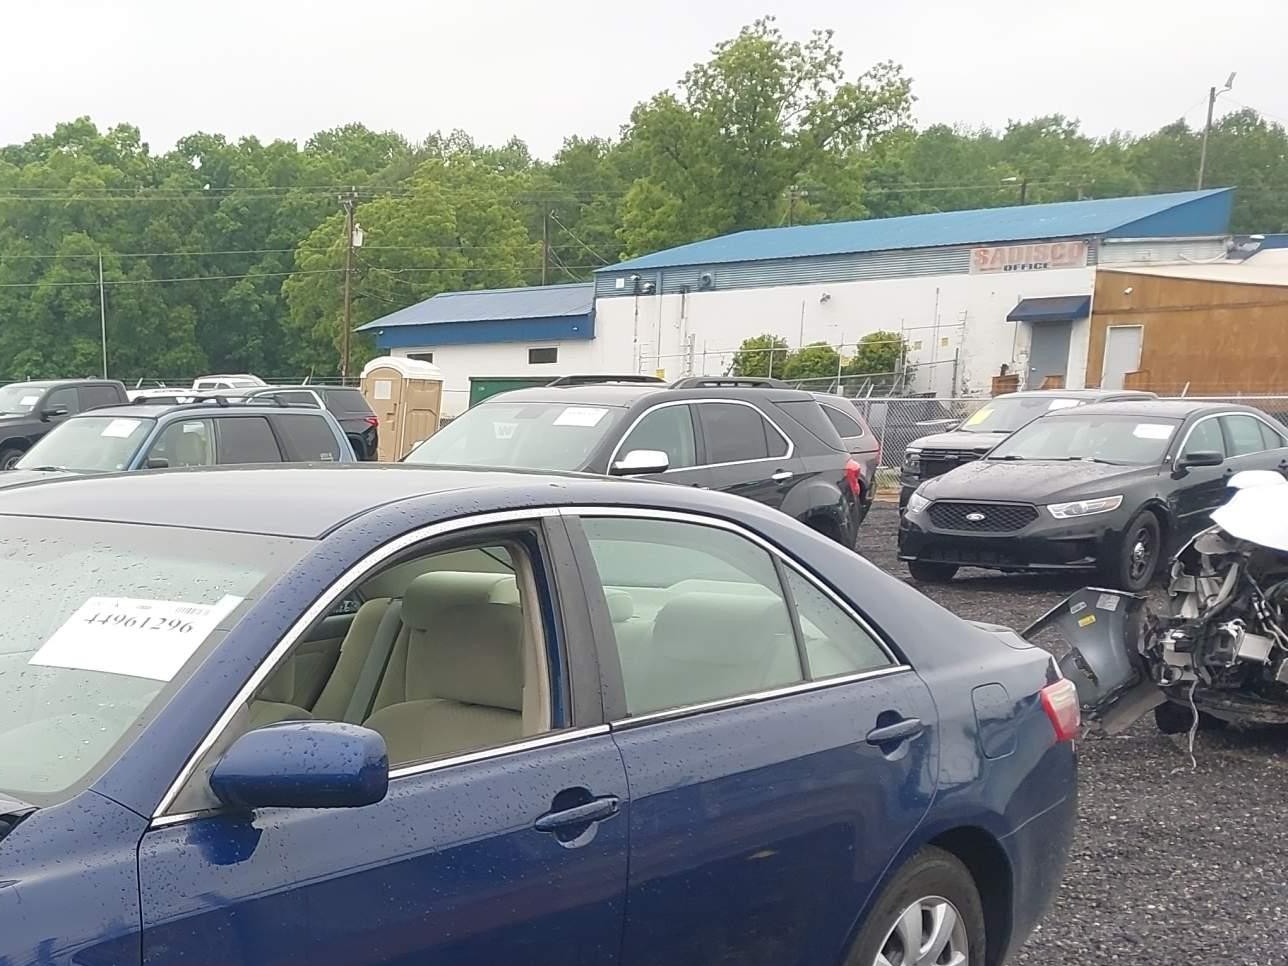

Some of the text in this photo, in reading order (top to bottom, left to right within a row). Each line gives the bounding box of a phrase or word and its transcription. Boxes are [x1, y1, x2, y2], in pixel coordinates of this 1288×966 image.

[976, 242, 1085, 266] SADISCO
[1003, 262, 1049, 272] OFFICE
[83, 612, 194, 634] 44961296
